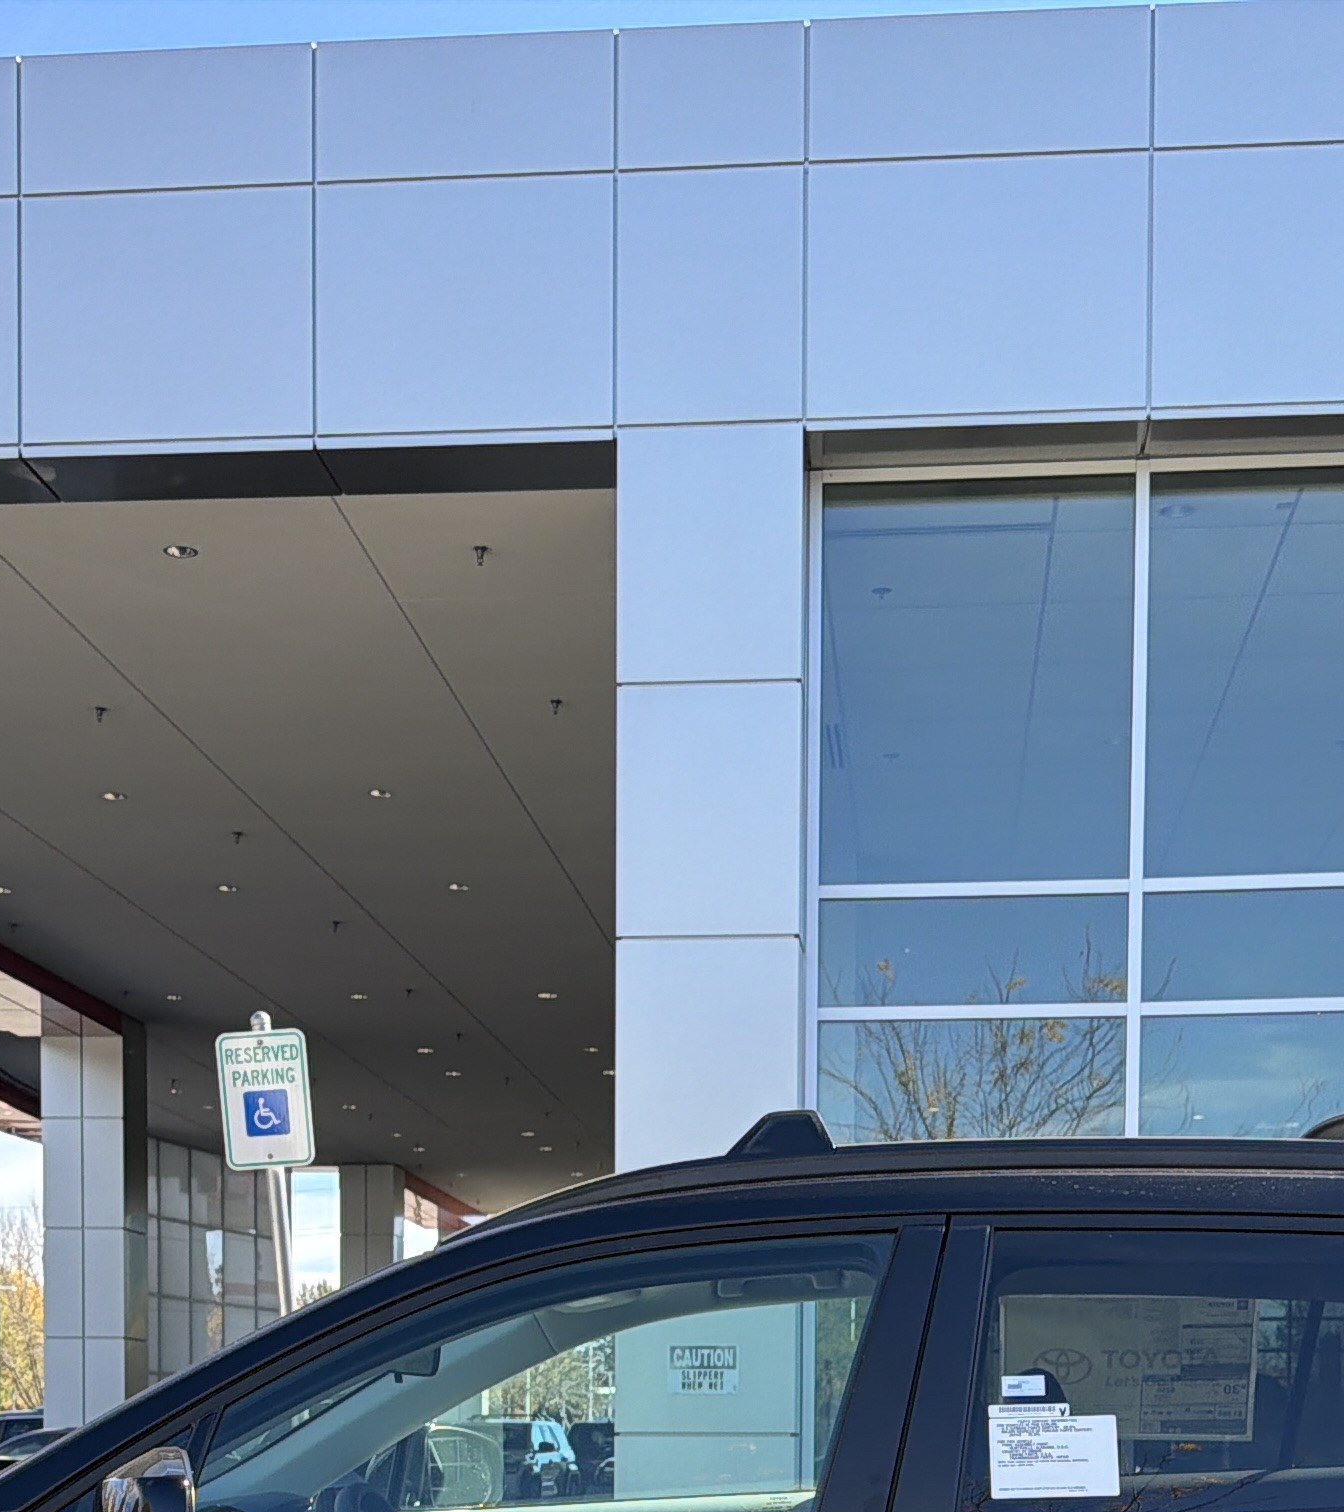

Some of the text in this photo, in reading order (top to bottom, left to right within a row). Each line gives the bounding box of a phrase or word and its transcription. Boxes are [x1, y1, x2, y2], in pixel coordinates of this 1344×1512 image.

[224, 1043, 299, 1065] RESERVED
[231, 1066, 296, 1087] PARKING
[673, 1348, 734, 1367] CAUTION
[681, 1370, 724, 1381] SLIPPERY
